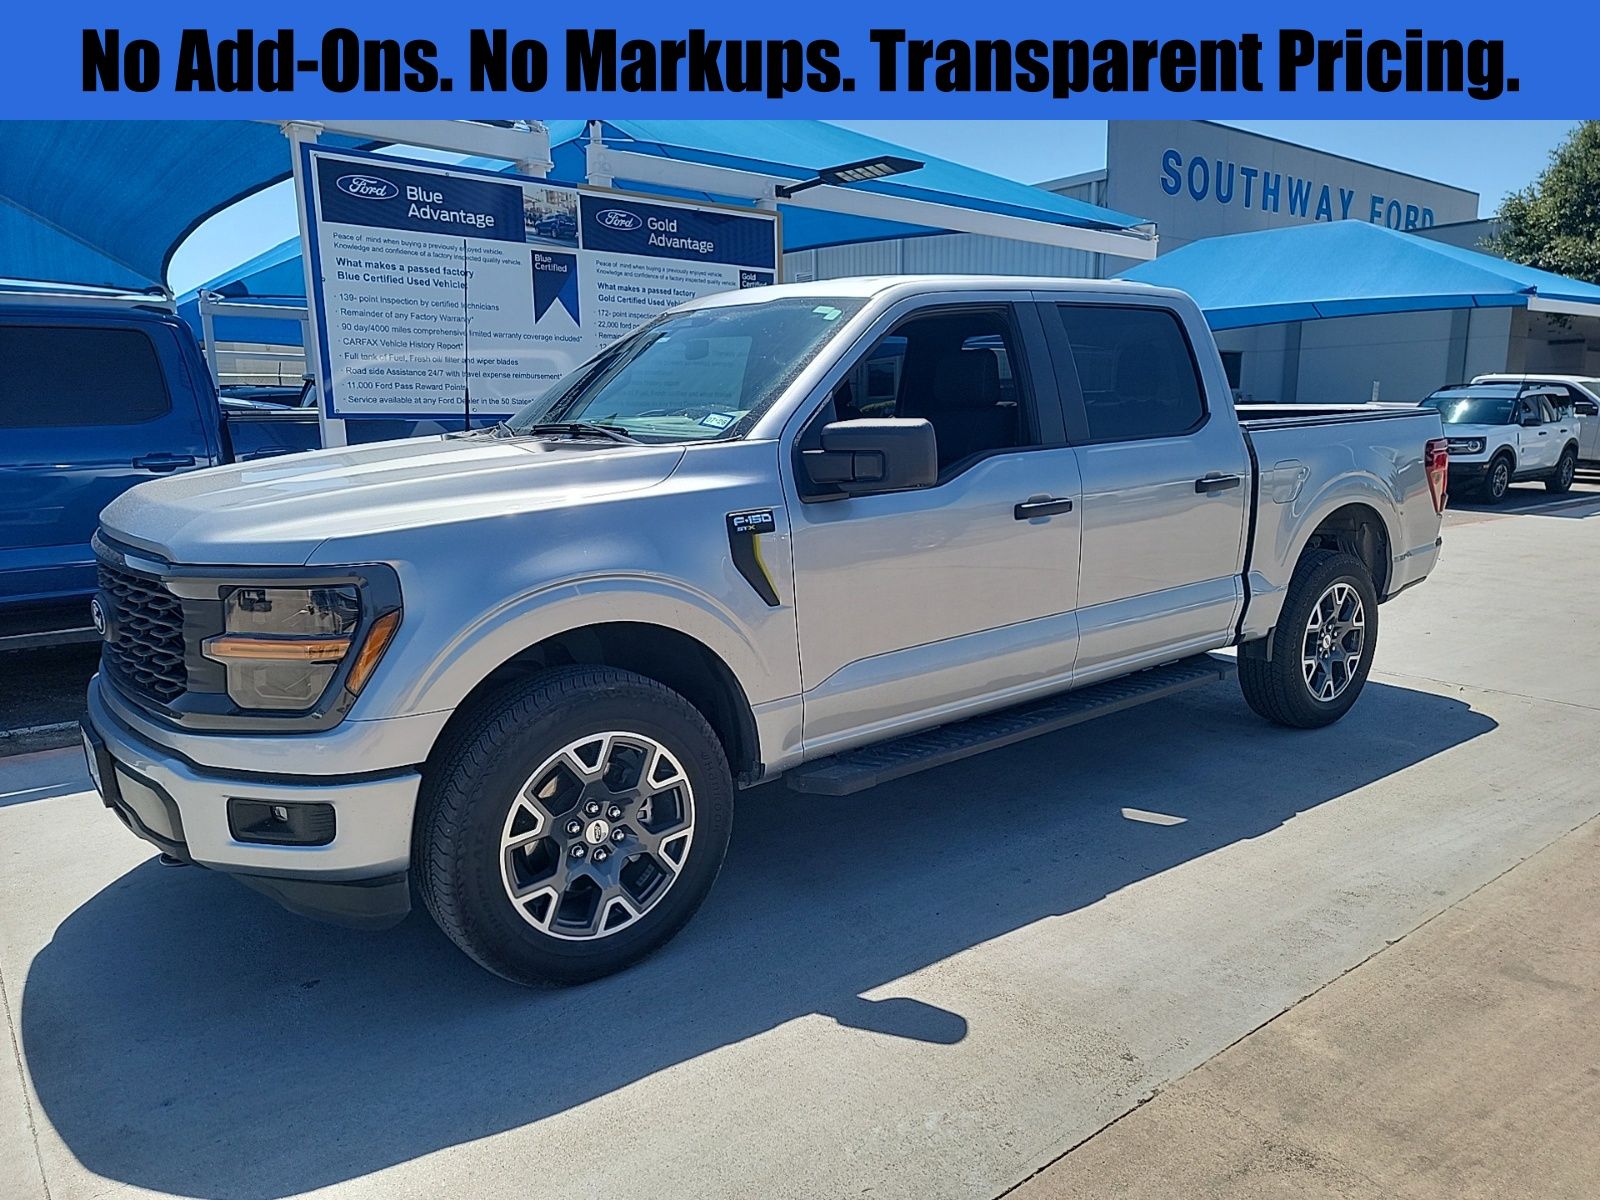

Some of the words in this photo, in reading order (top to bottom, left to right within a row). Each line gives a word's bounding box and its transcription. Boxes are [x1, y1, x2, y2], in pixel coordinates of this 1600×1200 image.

[348, 177, 388, 198] Ford
[406, 185, 444, 204] Blue
[1160, 149, 1355, 222] SOUTHWAY
[1369, 193, 1434, 231] FORD
[407, 202, 495, 228] Advantage
[604, 211, 635, 228] Ford
[647, 217, 678, 232] Gold
[332, 232, 354, 240] Peace
[400, 240, 422, 248] buying
[428, 243, 458, 252] previously
[648, 232, 714, 254] Advantage
[334, 242, 370, 252] Knowledge
[385, 248, 418, 256] confidence
[432, 252, 452, 260] factory
[482, 257, 500, 265] quality
[534, 254, 552, 263] Blue
[336, 256, 362, 268] What
[364, 261, 397, 271] makes
[408, 265, 440, 274] passed
[534, 262, 568, 272] Certified
[337, 270, 360, 281] Blue
[362, 273, 404, 285] Certified
[406, 276, 430, 287] Used
[741, 272, 757, 280] Gold
[597, 282, 616, 291] What
[618, 284, 640, 292] makes
[648, 288, 672, 296] passed
[673, 288, 696, 298] factory
[358, 294, 378, 304] point
[420, 298, 429, 308] by
[430, 300, 459, 308] certified
[460, 302, 500, 311] tchnicians
[598, 294, 616, 302] Gold
[616, 296, 646, 305] Certified
[648, 298, 665, 306] Used
[340, 308, 384, 318] Remainder
[410, 312, 438, 323] Factory
[341, 322, 352, 331] 90
[353, 324, 390, 334] day/4000
[391, 326, 412, 334] miles
[468, 330, 492, 338] limited
[492, 332, 522, 340] warranty
[522, 334, 553, 342] coverage
[598, 321, 618, 330] 22,000
[342, 337, 378, 347] CARFAX
[380, 338, 406, 348] Vehicle
[409, 340, 436, 350] History
[344, 352, 359, 360] Full
[360, 352, 378, 360] tank
[410, 354, 431, 362] Fresh
[345, 366, 367, 375] Road
[368, 368, 385, 376] side
[386, 368, 427, 377] Assistance
[428, 369, 444, 377] 24/7
[414, 382, 443, 390] Reward
[348, 395, 378, 404] Service
[422, 398, 436, 406] any
[438, 396, 454, 404] Ford
[456, 397, 480, 405] Deler
[733, 513, 772, 526] F-150
